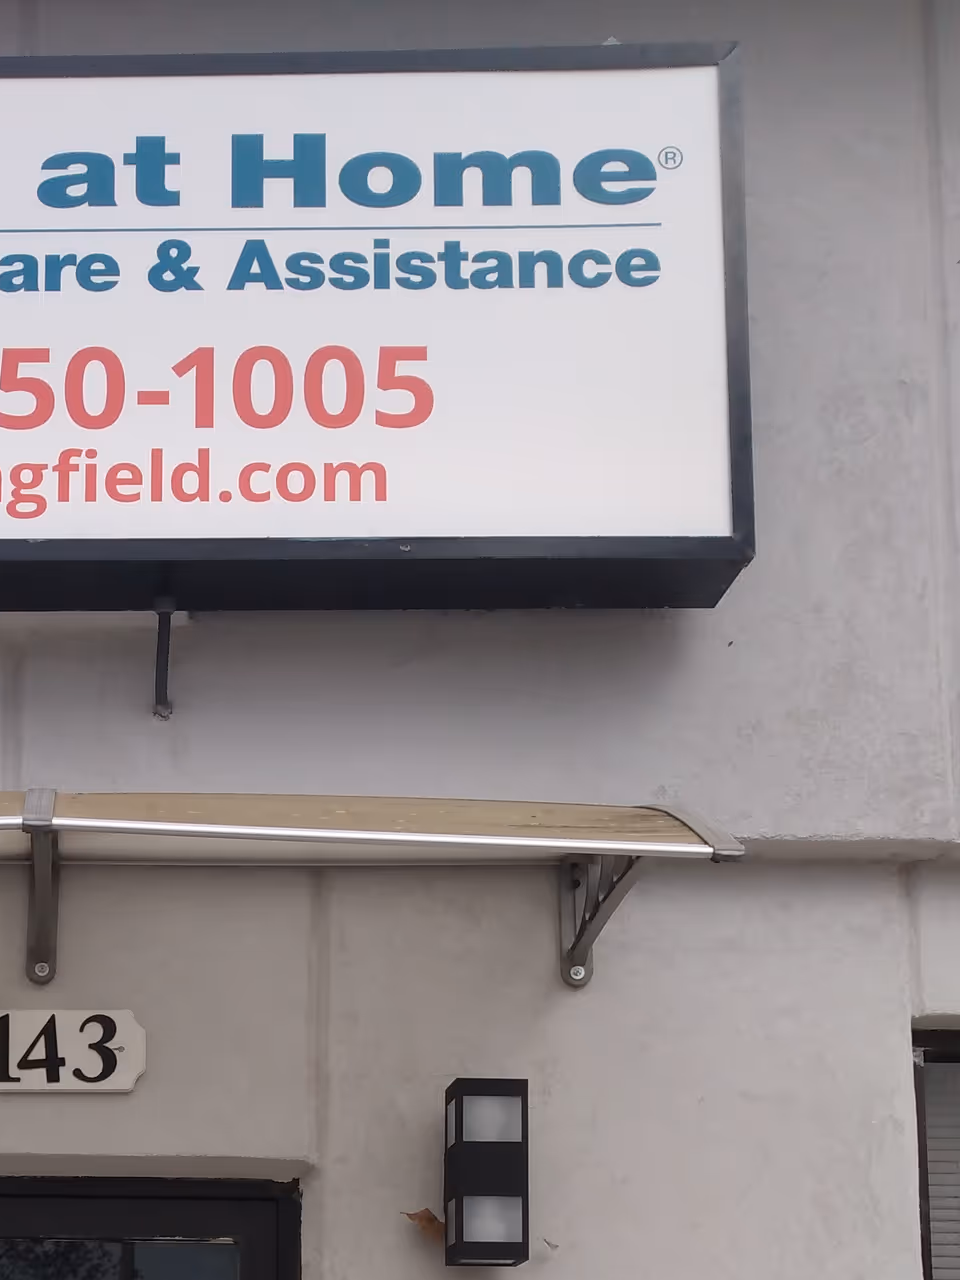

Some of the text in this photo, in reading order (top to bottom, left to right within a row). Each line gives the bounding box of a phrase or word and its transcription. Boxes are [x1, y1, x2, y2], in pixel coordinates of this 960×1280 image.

[37, 134, 182, 209] at
[147, 239, 204, 292] &
[226, 237, 662, 291] Assistance
